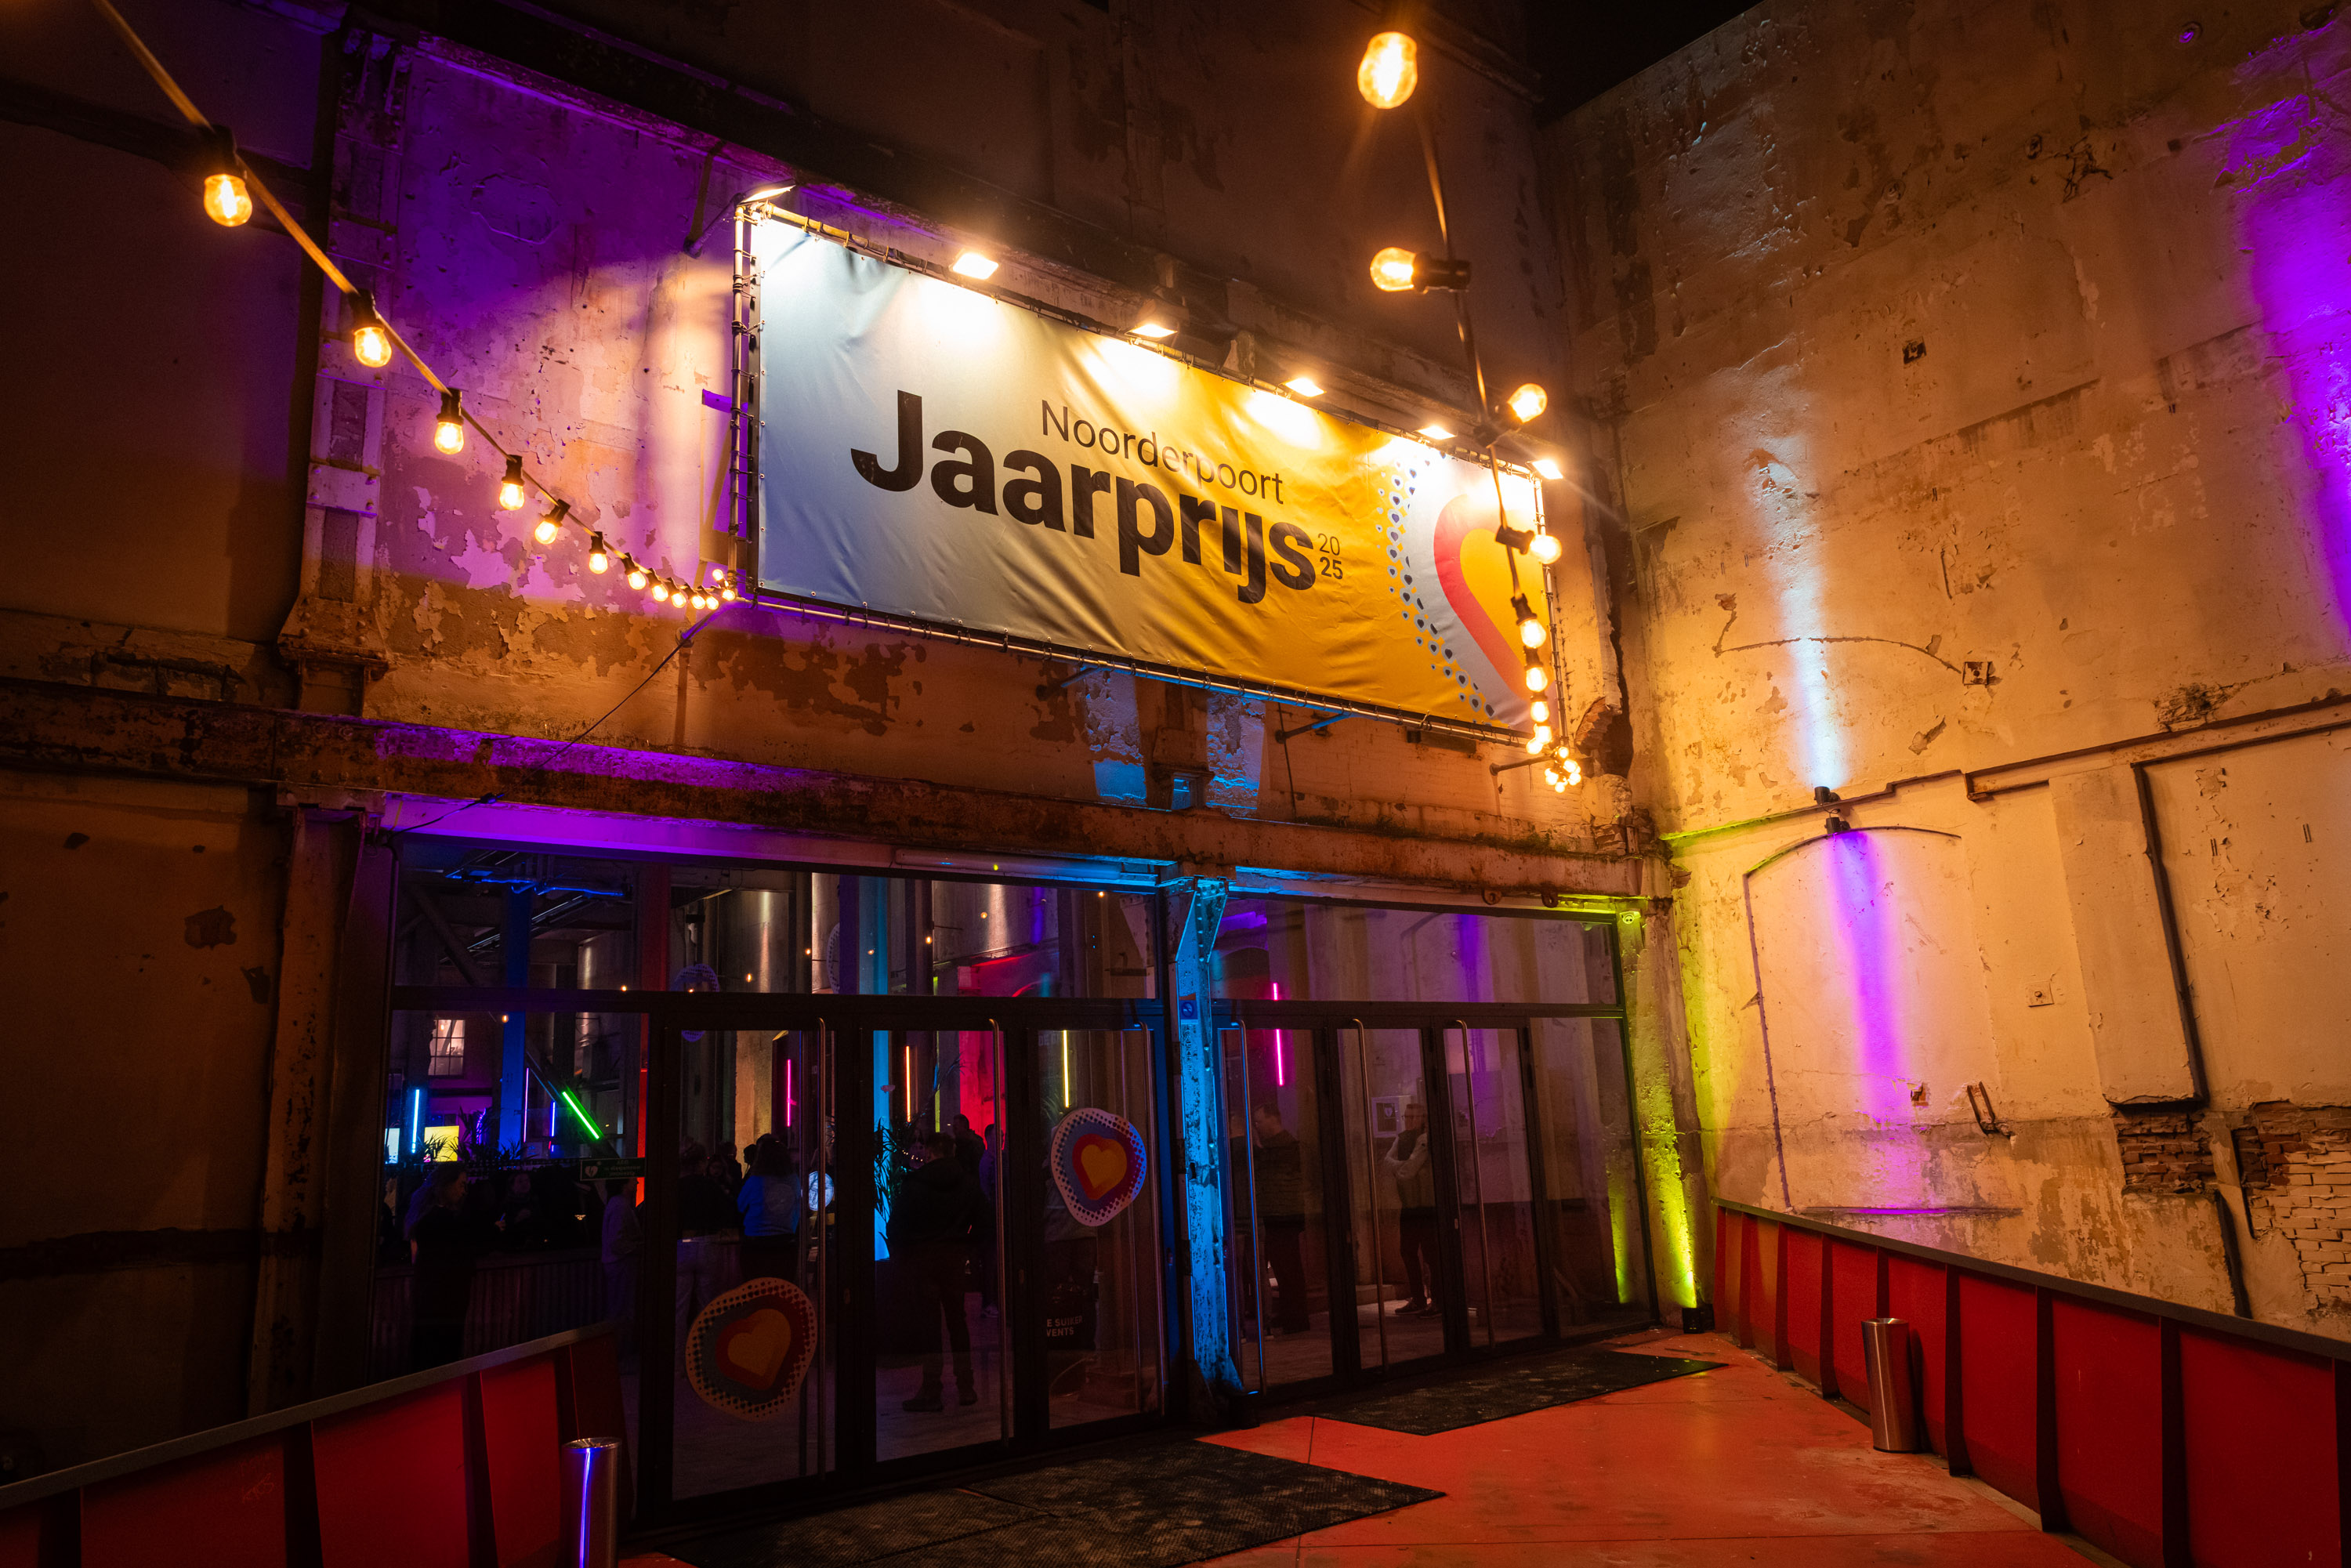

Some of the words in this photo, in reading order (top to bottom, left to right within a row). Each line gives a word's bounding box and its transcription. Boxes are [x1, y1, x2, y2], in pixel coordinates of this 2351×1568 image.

[1041, 400, 1284, 504] Noorderpoort
[850, 389, 1317, 604] Jaarprijs
[1318, 533, 1340, 556] 20
[1320, 556, 1343, 579] 25
[1046, 1318, 1052, 1327] E
[1055, 1316, 1082, 1327] SUIKER
[1046, 1327, 1074, 1338] VENTS
